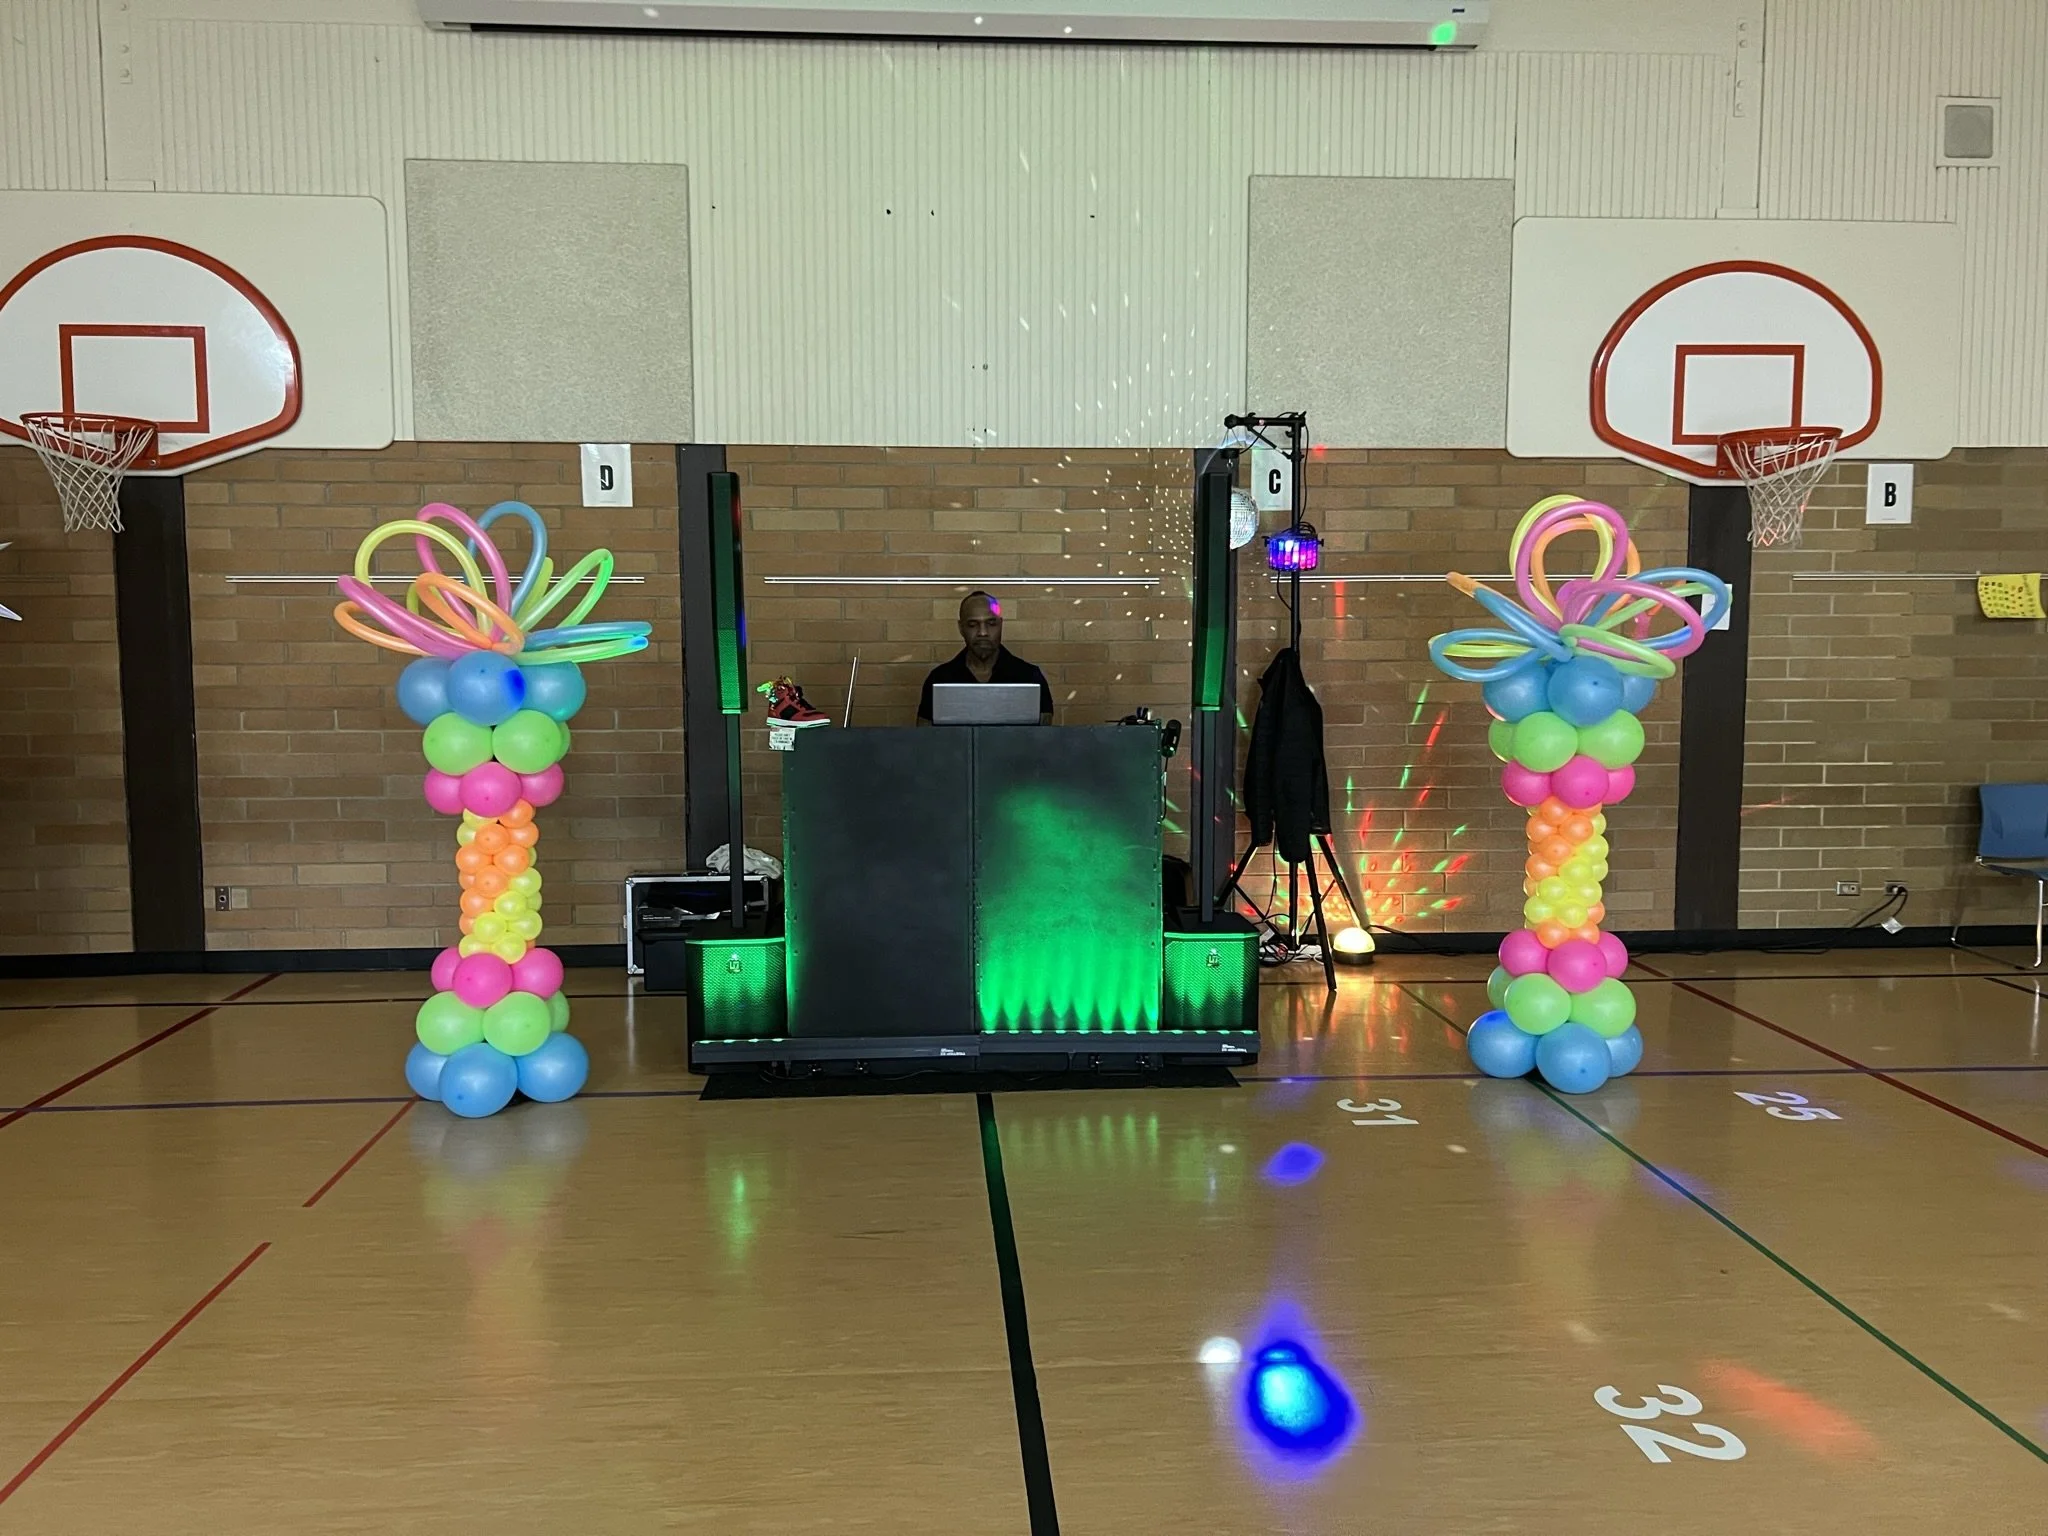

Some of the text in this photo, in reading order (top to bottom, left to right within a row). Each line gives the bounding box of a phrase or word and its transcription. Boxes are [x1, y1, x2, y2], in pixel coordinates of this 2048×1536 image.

[600, 465, 613, 490] D
[1269, 469, 1281, 494] C
[1884, 482, 1896, 507] B
[1336, 1098, 1420, 1126] 31
[1733, 1091, 1843, 1120] 25
[1594, 1384, 1746, 1463] 32
